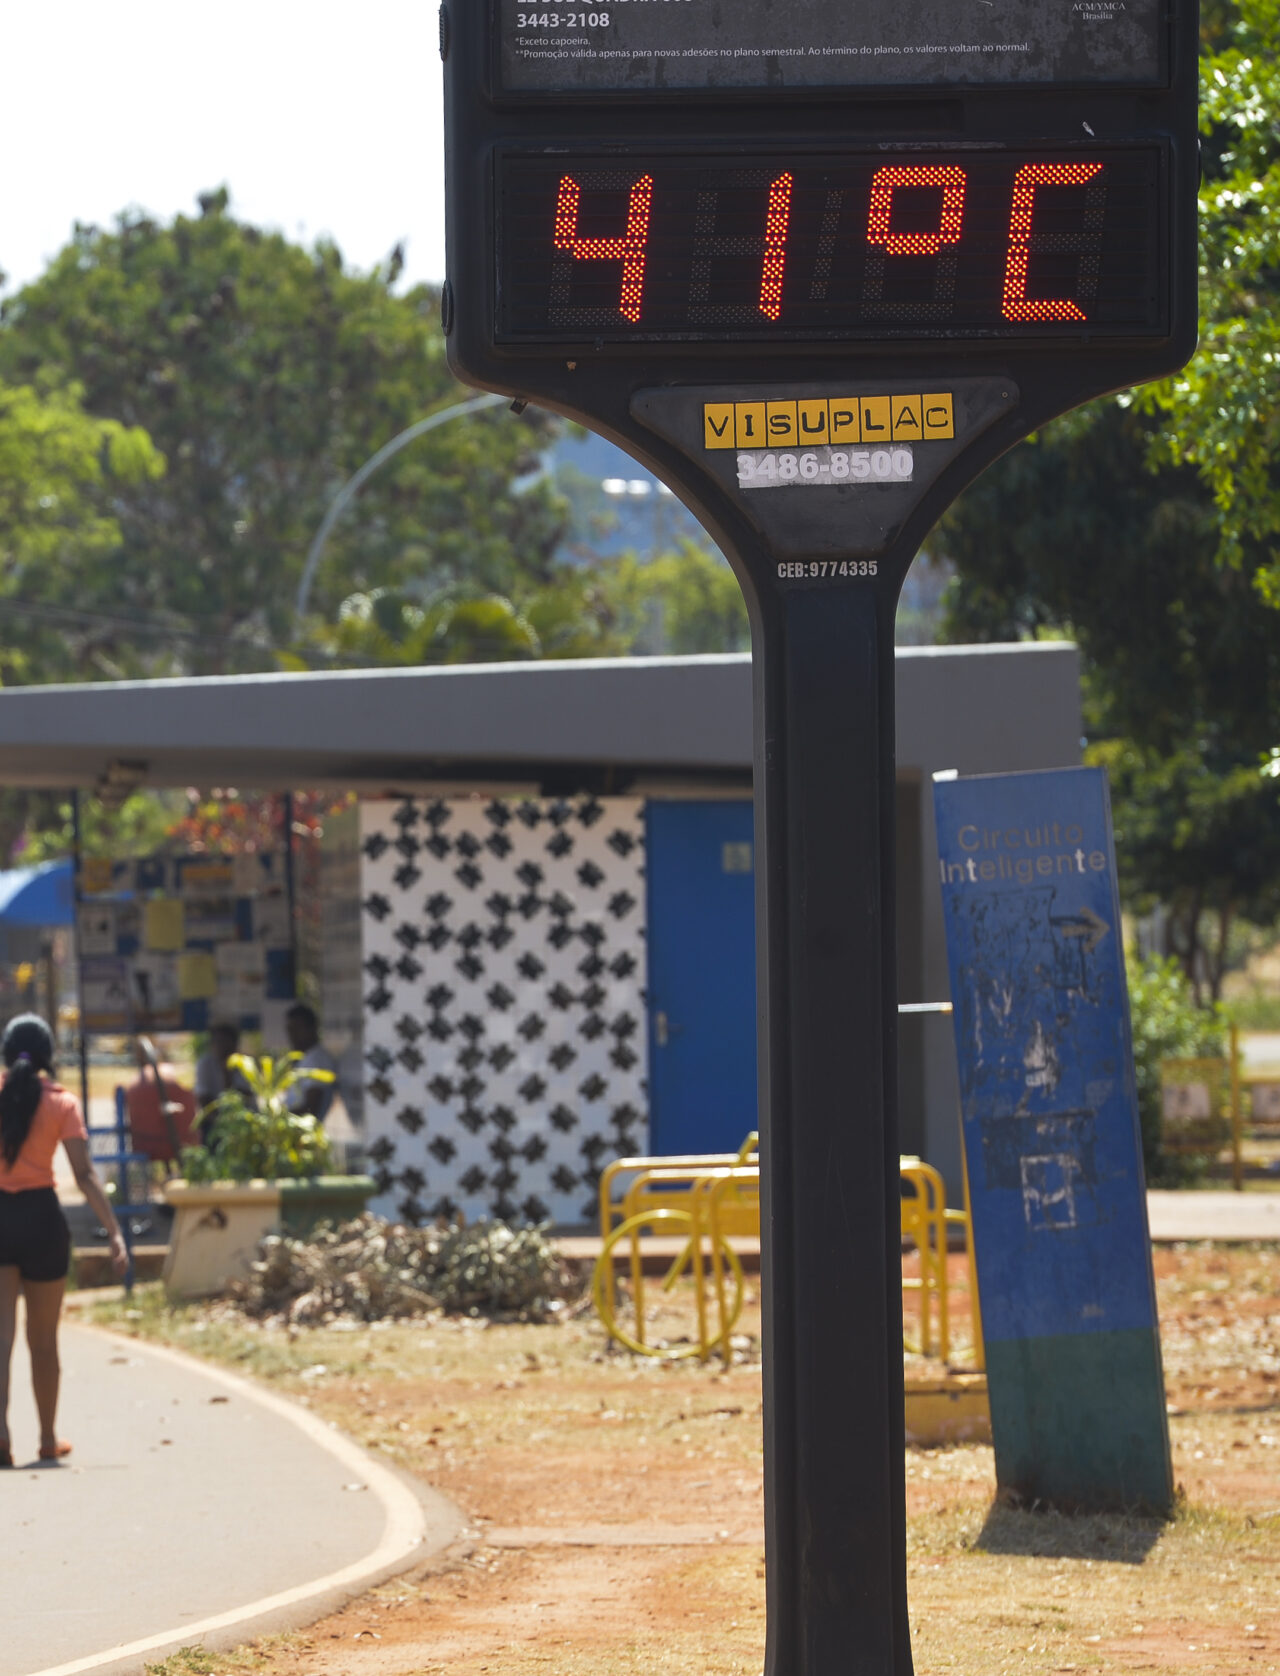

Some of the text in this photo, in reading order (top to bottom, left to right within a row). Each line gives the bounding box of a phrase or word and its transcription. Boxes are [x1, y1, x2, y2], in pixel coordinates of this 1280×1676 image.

[1072, 2, 1126, 11] ACM/YMCA
[516, 12, 610, 28] 3443-2108
[550, 36, 591, 47] capoeira.
[570, 48, 597, 58] válida
[598, 49, 631, 60] apenas
[632, 49, 653, 59] para
[654, 49, 681, 57] novas
[682, 47, 719, 57] adesões
[720, 49, 732, 57] no
[734, 47, 759, 58] plano
[761, 46, 806, 56] semestral.
[808, 46, 821, 56] Ao
[822, 45, 856, 56] término
[859, 45, 872, 54] do
[874, 45, 901, 56] plano,
[916, 43, 948, 53] valores
[949, 42, 981, 53] voltam
[995, 42, 1031, 52] normal.
[707, 406, 949, 437] VISUPLAC
[736, 450, 913, 481] 3486-8500
[777, 560, 878, 578] CEB:9774335
[958, 821, 1084, 852] Circuito
[939, 848, 1107, 884] Inteligente
